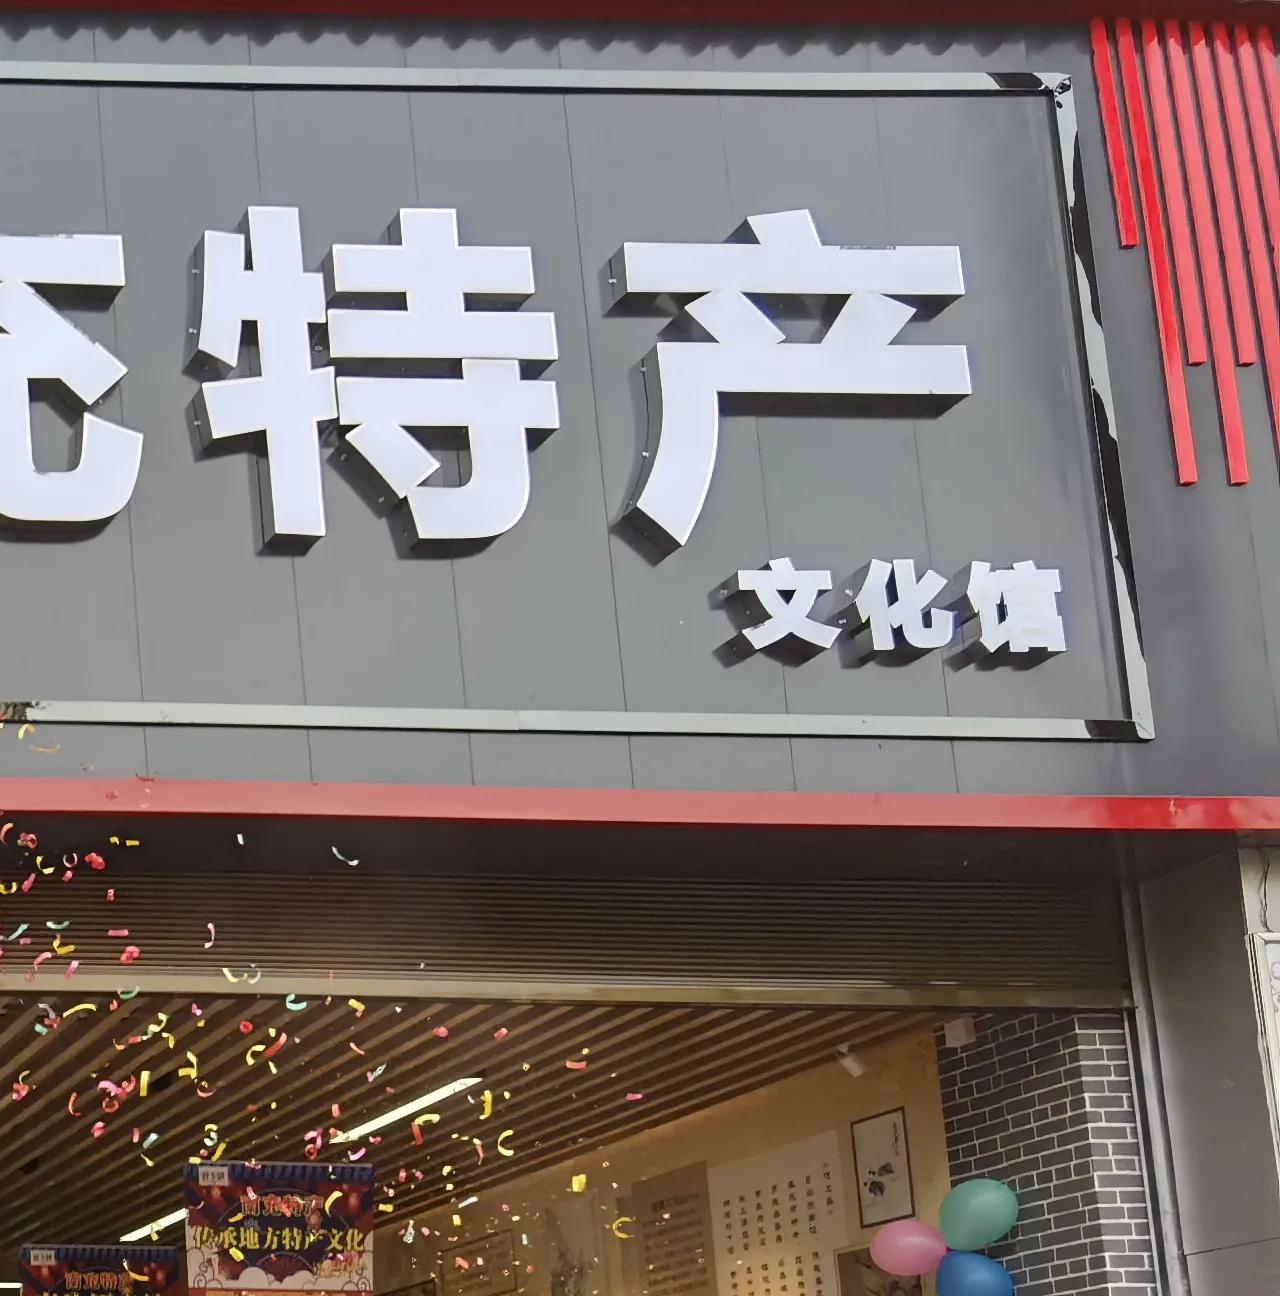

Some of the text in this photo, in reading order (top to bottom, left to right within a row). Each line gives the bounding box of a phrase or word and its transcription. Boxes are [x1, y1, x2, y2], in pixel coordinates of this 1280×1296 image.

[737, 556, 1067, 653] 文化馆
[193, 1226, 365, 1251] 传承地方特产文化
